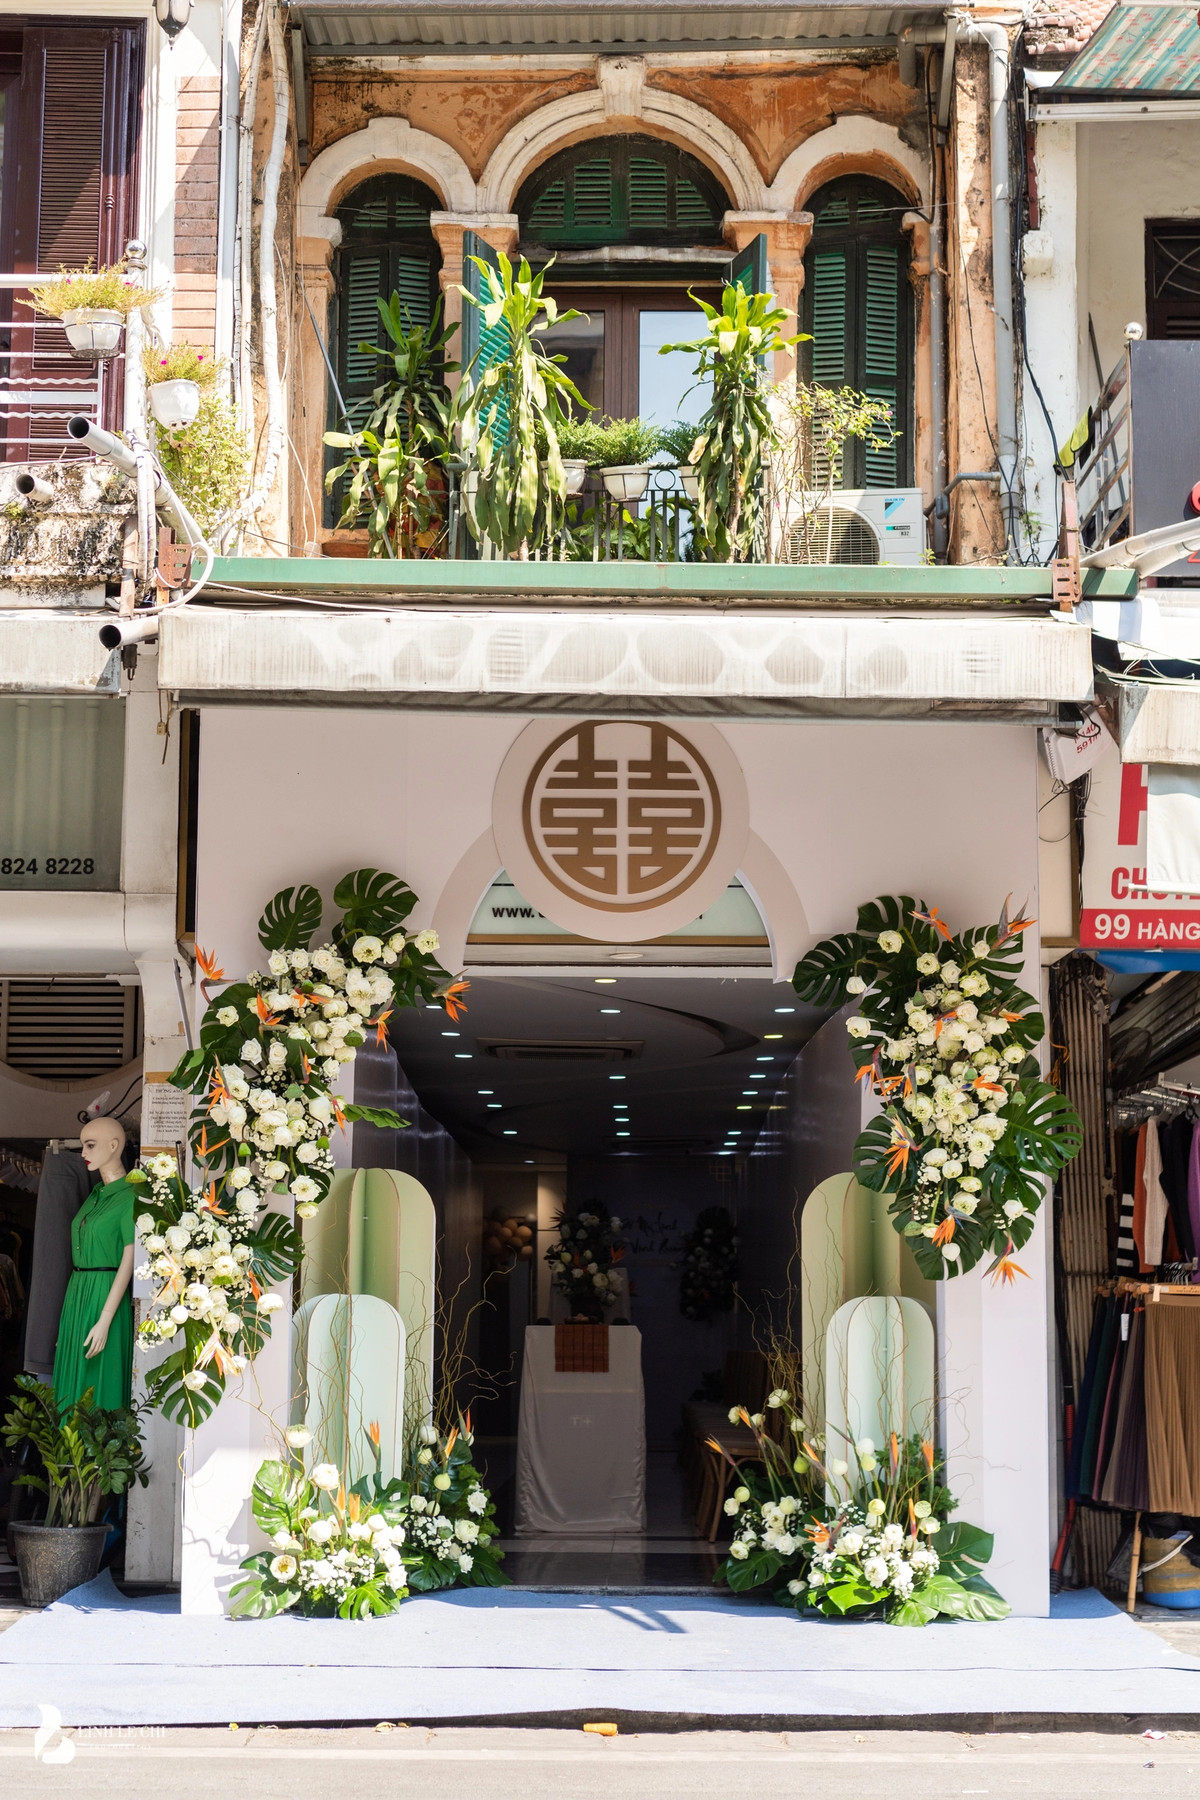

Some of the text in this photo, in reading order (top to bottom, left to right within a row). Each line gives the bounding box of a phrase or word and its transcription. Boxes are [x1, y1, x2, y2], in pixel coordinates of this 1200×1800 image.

[1, 858, 94, 874] 824 8228
[1094, 913, 1200, 940] 99 HÀNG
